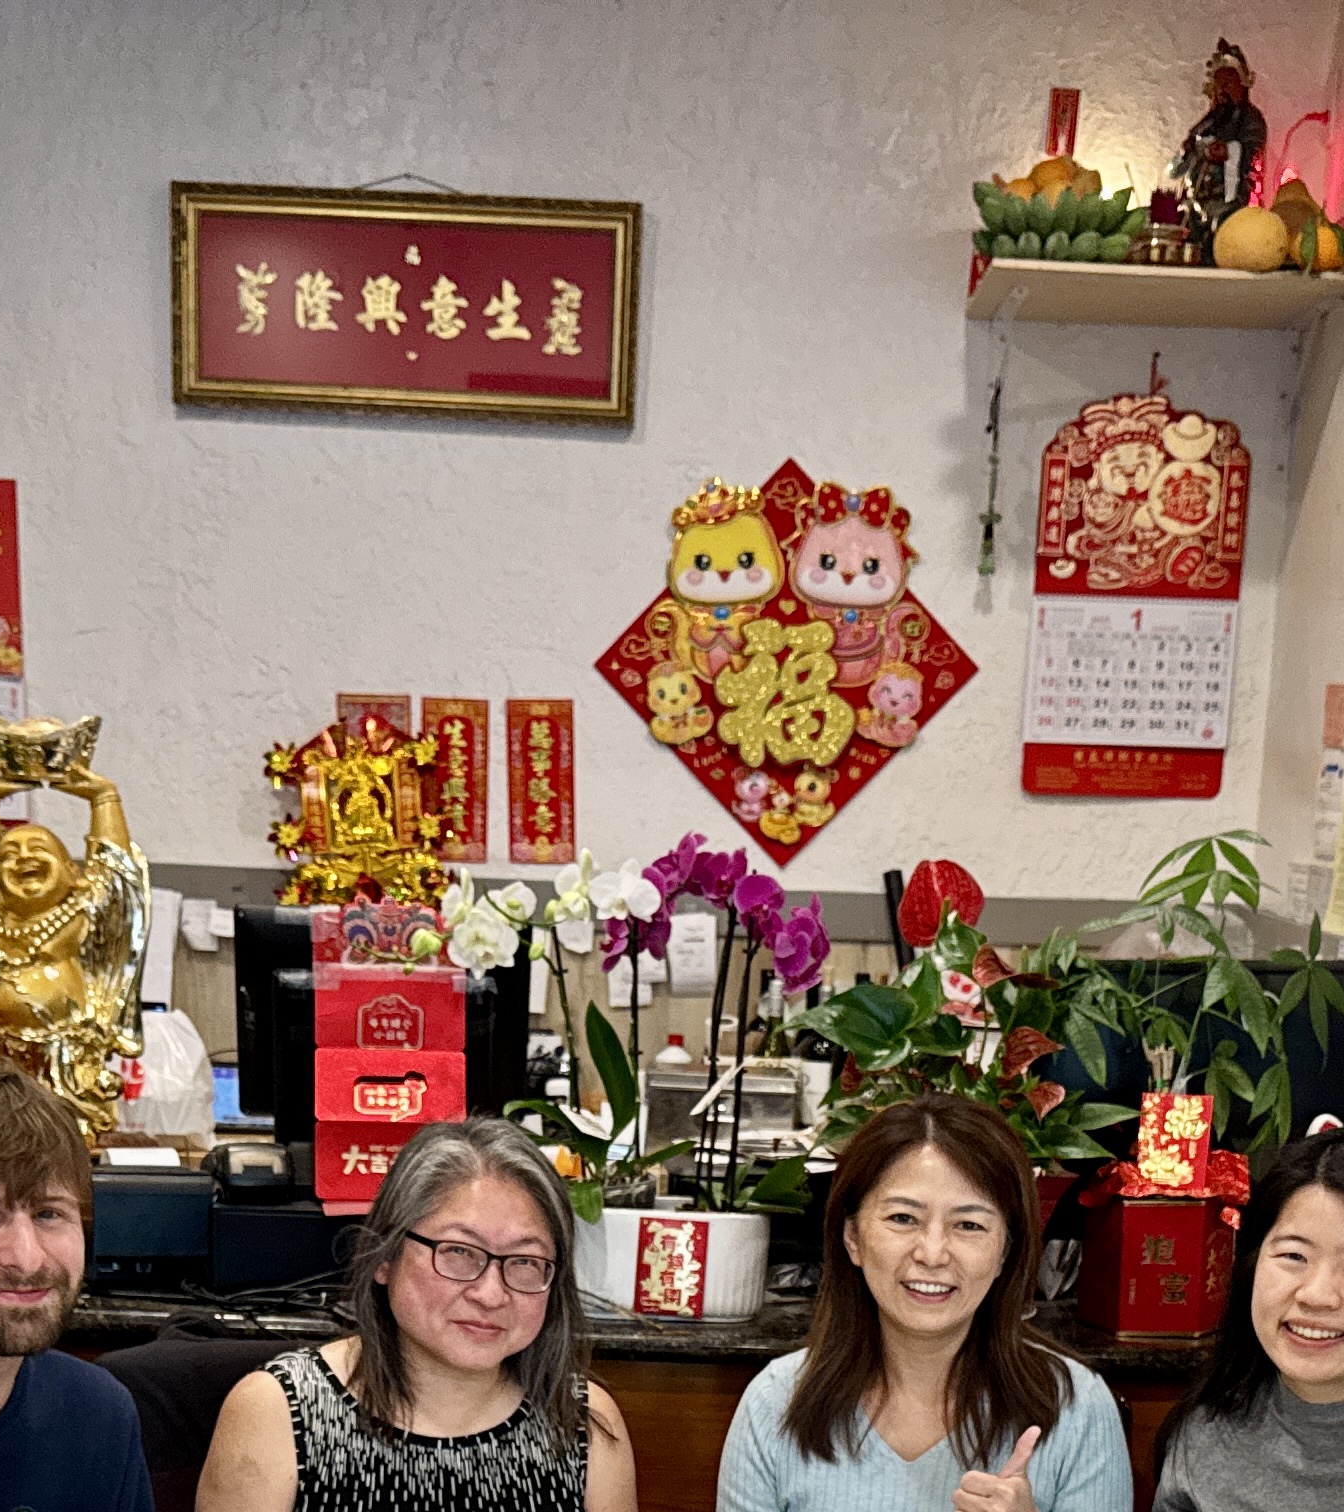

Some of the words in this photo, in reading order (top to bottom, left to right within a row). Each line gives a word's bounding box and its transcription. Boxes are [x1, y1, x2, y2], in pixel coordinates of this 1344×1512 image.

[1131, 608, 1143, 631] 1
[713, 618, 856, 767] 福
[341, 1144, 397, 1175] 大吉
